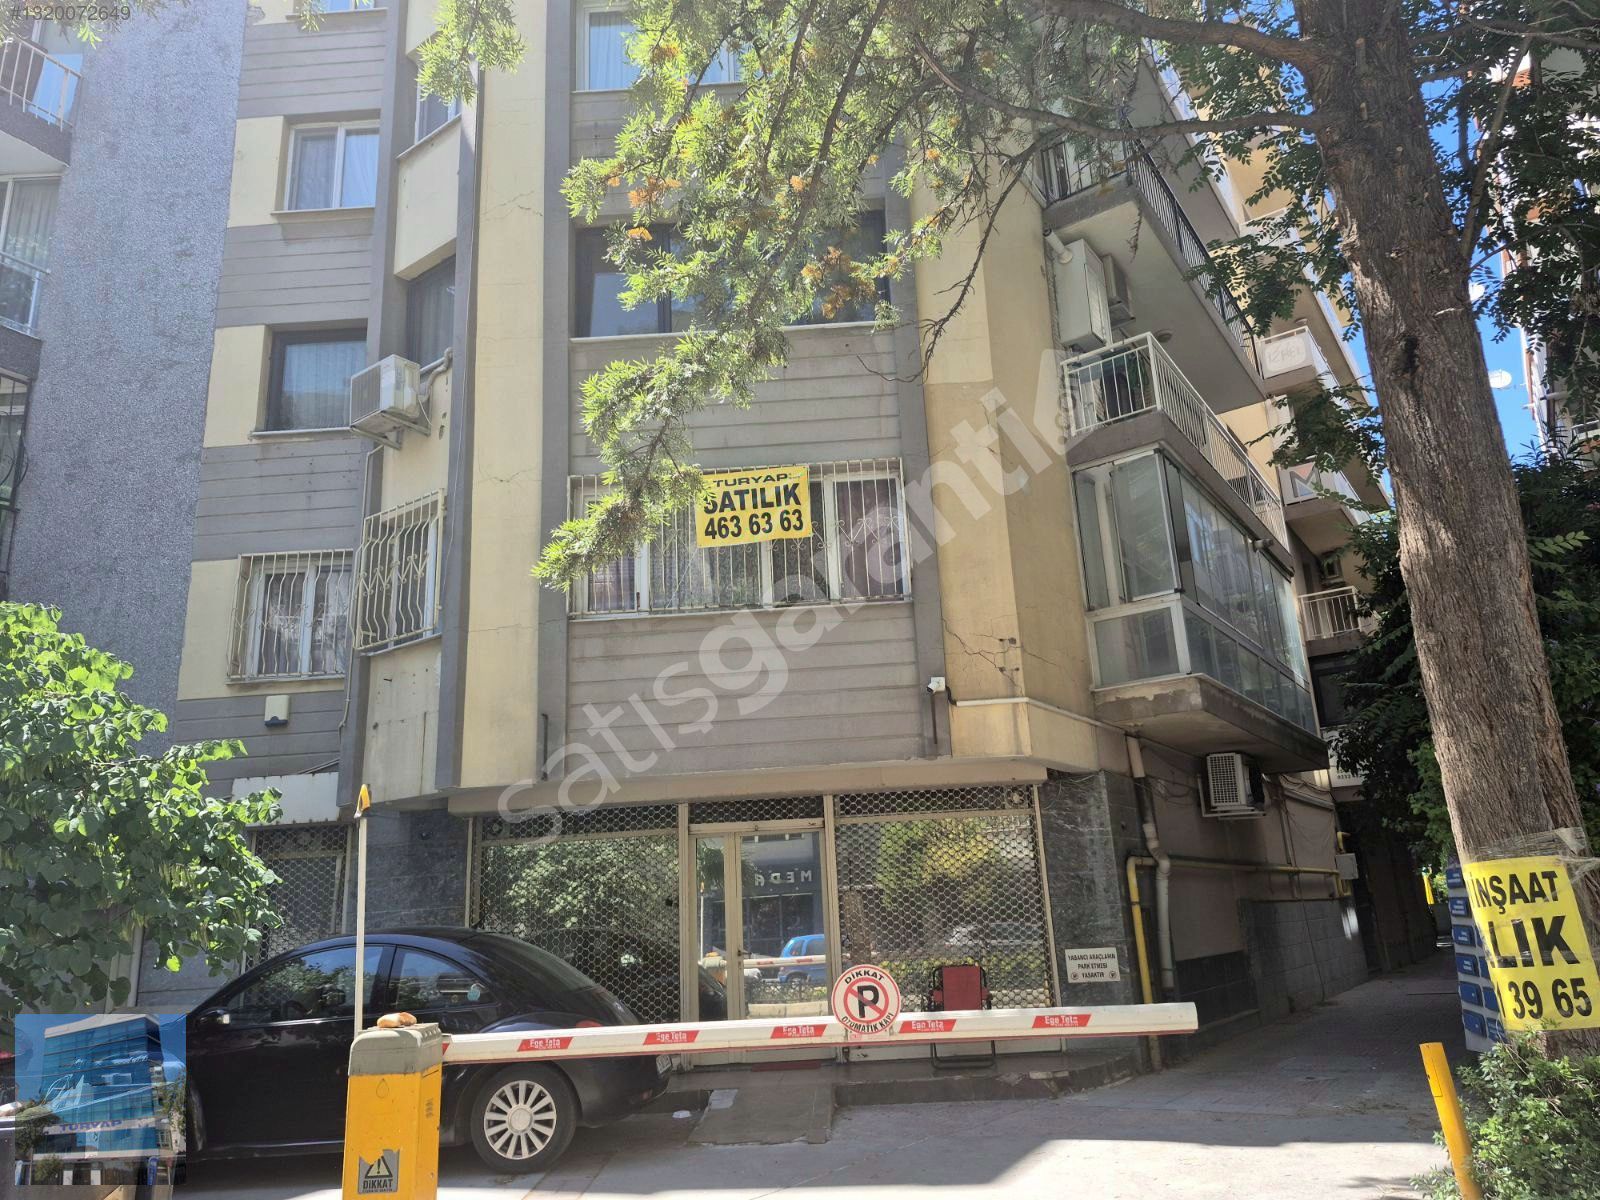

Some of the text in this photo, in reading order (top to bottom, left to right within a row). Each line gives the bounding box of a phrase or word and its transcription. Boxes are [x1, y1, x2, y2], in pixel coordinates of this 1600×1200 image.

[713, 473, 788, 487] TURYAP
[704, 509, 803, 539] 463 63 63
[1488, 915, 1580, 969] LIK
[1508, 980, 1544, 1019] 39
[1551, 977, 1593, 1018] 65
